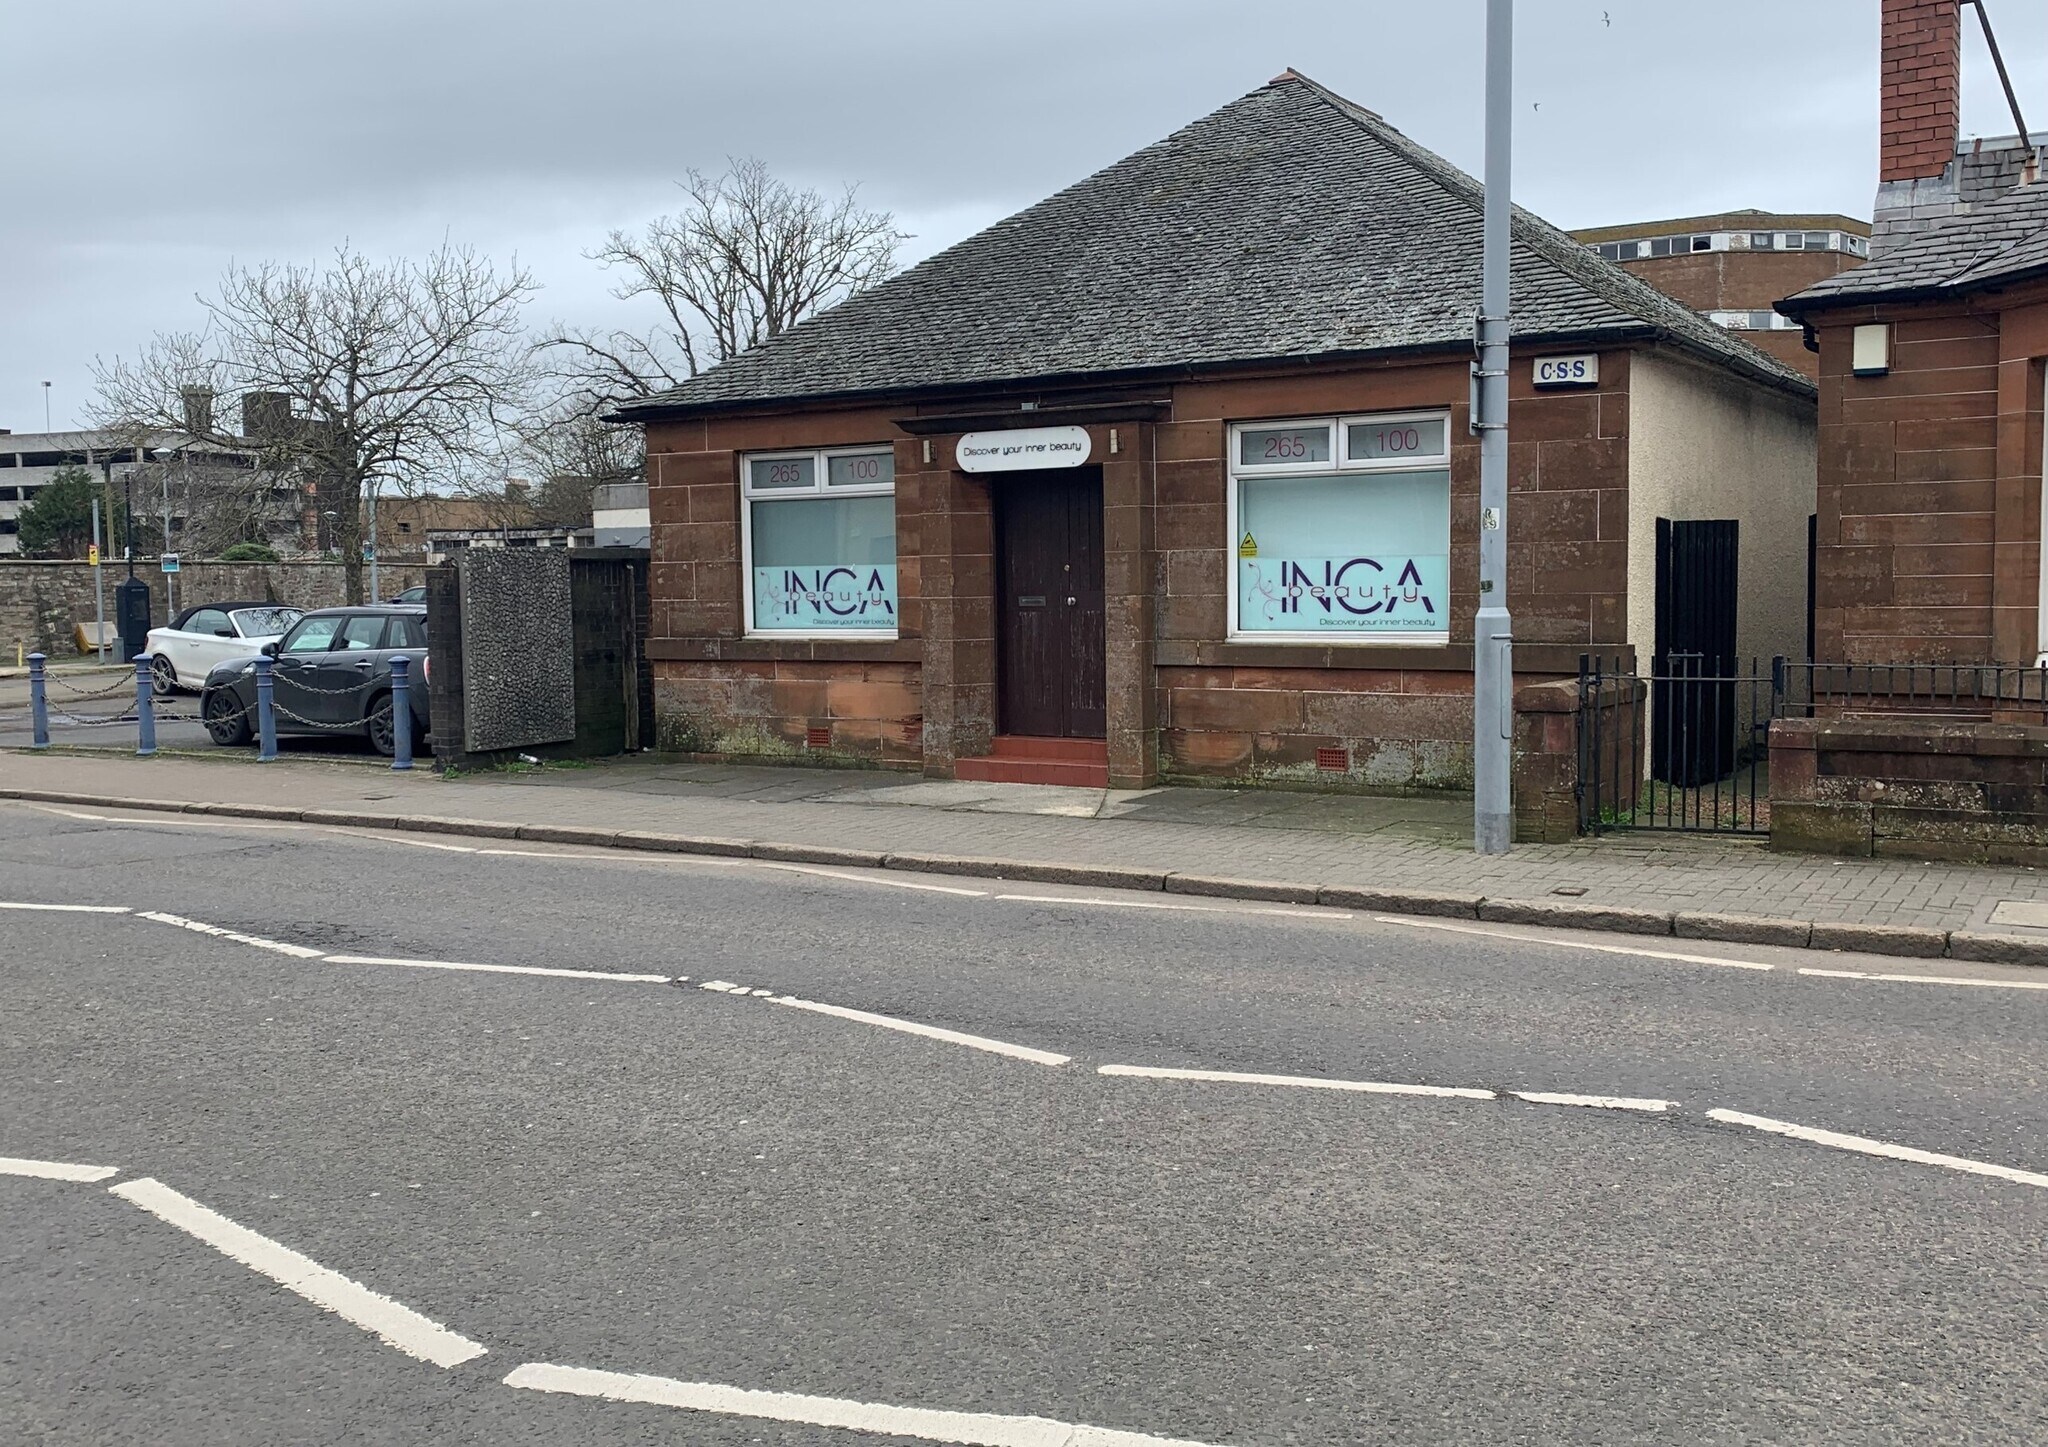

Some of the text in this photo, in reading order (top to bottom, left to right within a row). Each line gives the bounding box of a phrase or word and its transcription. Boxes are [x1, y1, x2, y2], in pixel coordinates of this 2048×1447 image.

[963, 442, 1081, 457] Discover your inner beauty
[1264, 429, 1419, 458] 265 100
[770, 459, 879, 483] 265 100
[784, 567, 895, 616] INCA
[789, 588, 882, 606] beauty
[1281, 558, 1435, 615] INCA
[1288, 582, 1418, 603] beauty
[812, 618, 895, 626] Discover your inner beauty
[1319, 617, 1436, 627] Discover your inner beauty
